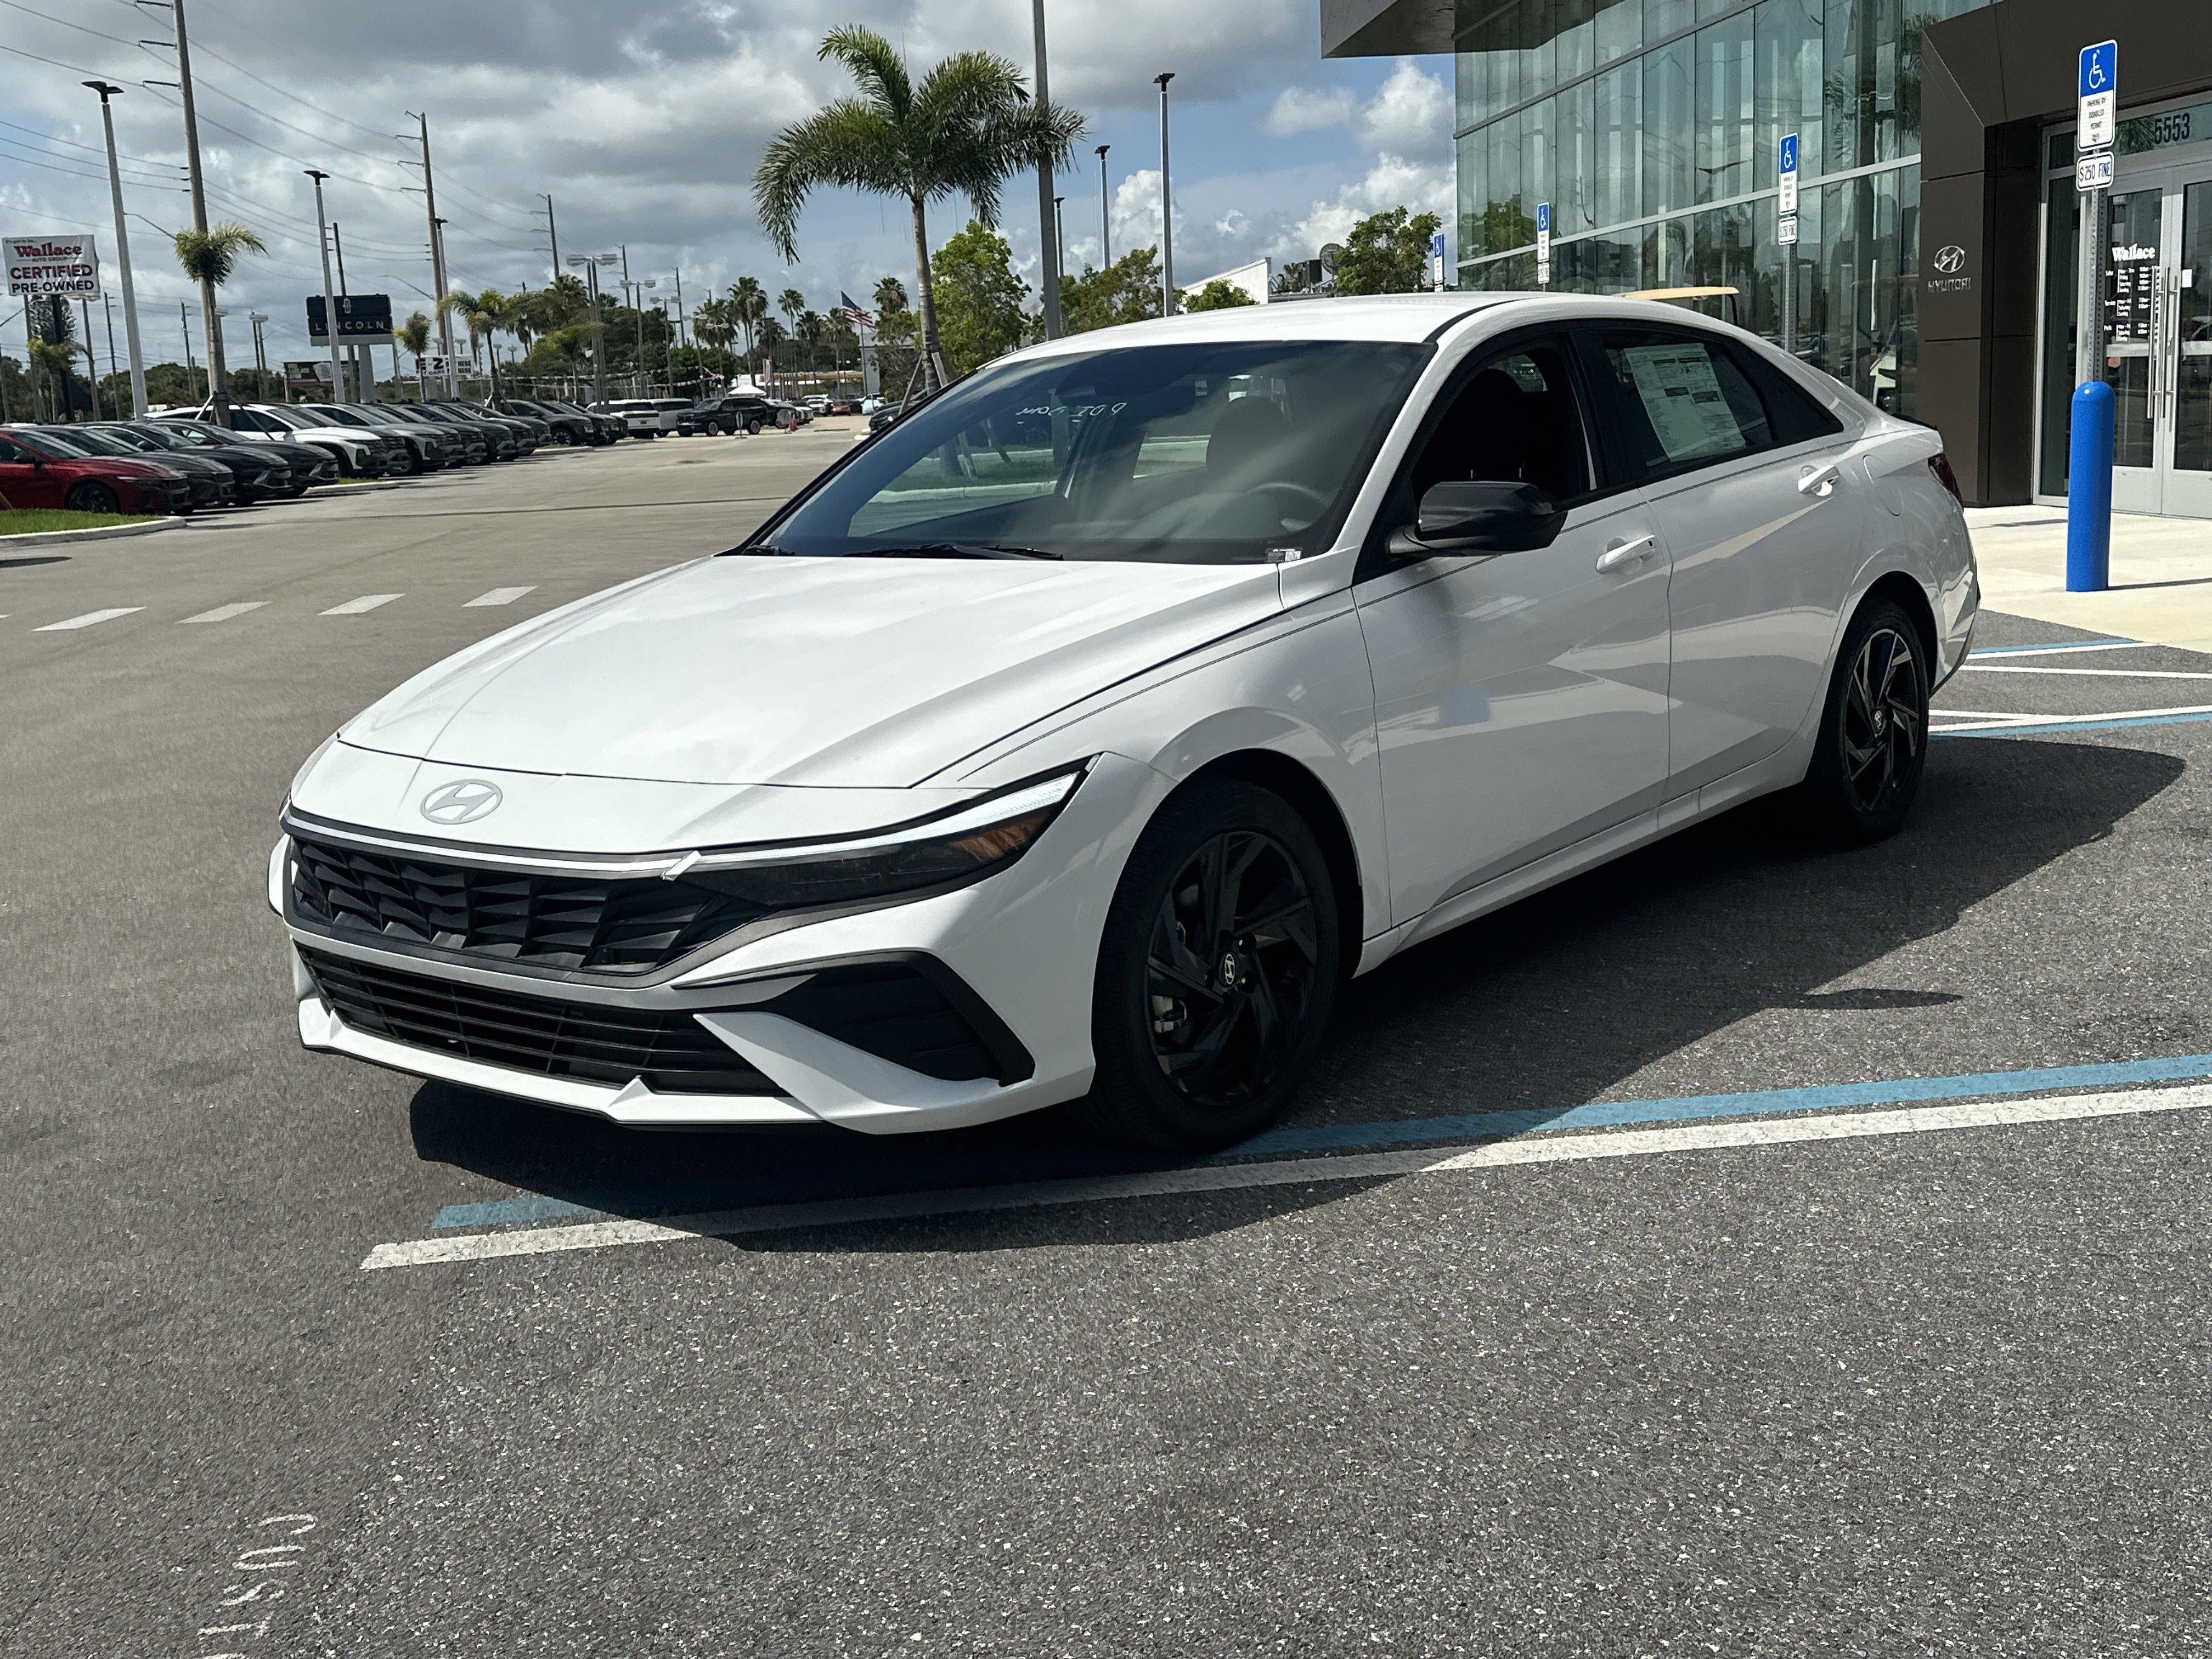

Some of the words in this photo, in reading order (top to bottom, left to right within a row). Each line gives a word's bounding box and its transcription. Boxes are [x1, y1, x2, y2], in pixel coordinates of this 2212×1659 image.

[2154, 112, 2190, 145] 5553
[14, 242, 82, 257] Wallace
[2112, 243, 2155, 262] Wallace
[10, 264, 93, 279] CERTIFIED
[11, 280, 94, 294] PRE-OWNED
[1928, 277, 1971, 294] HYUNDAI
